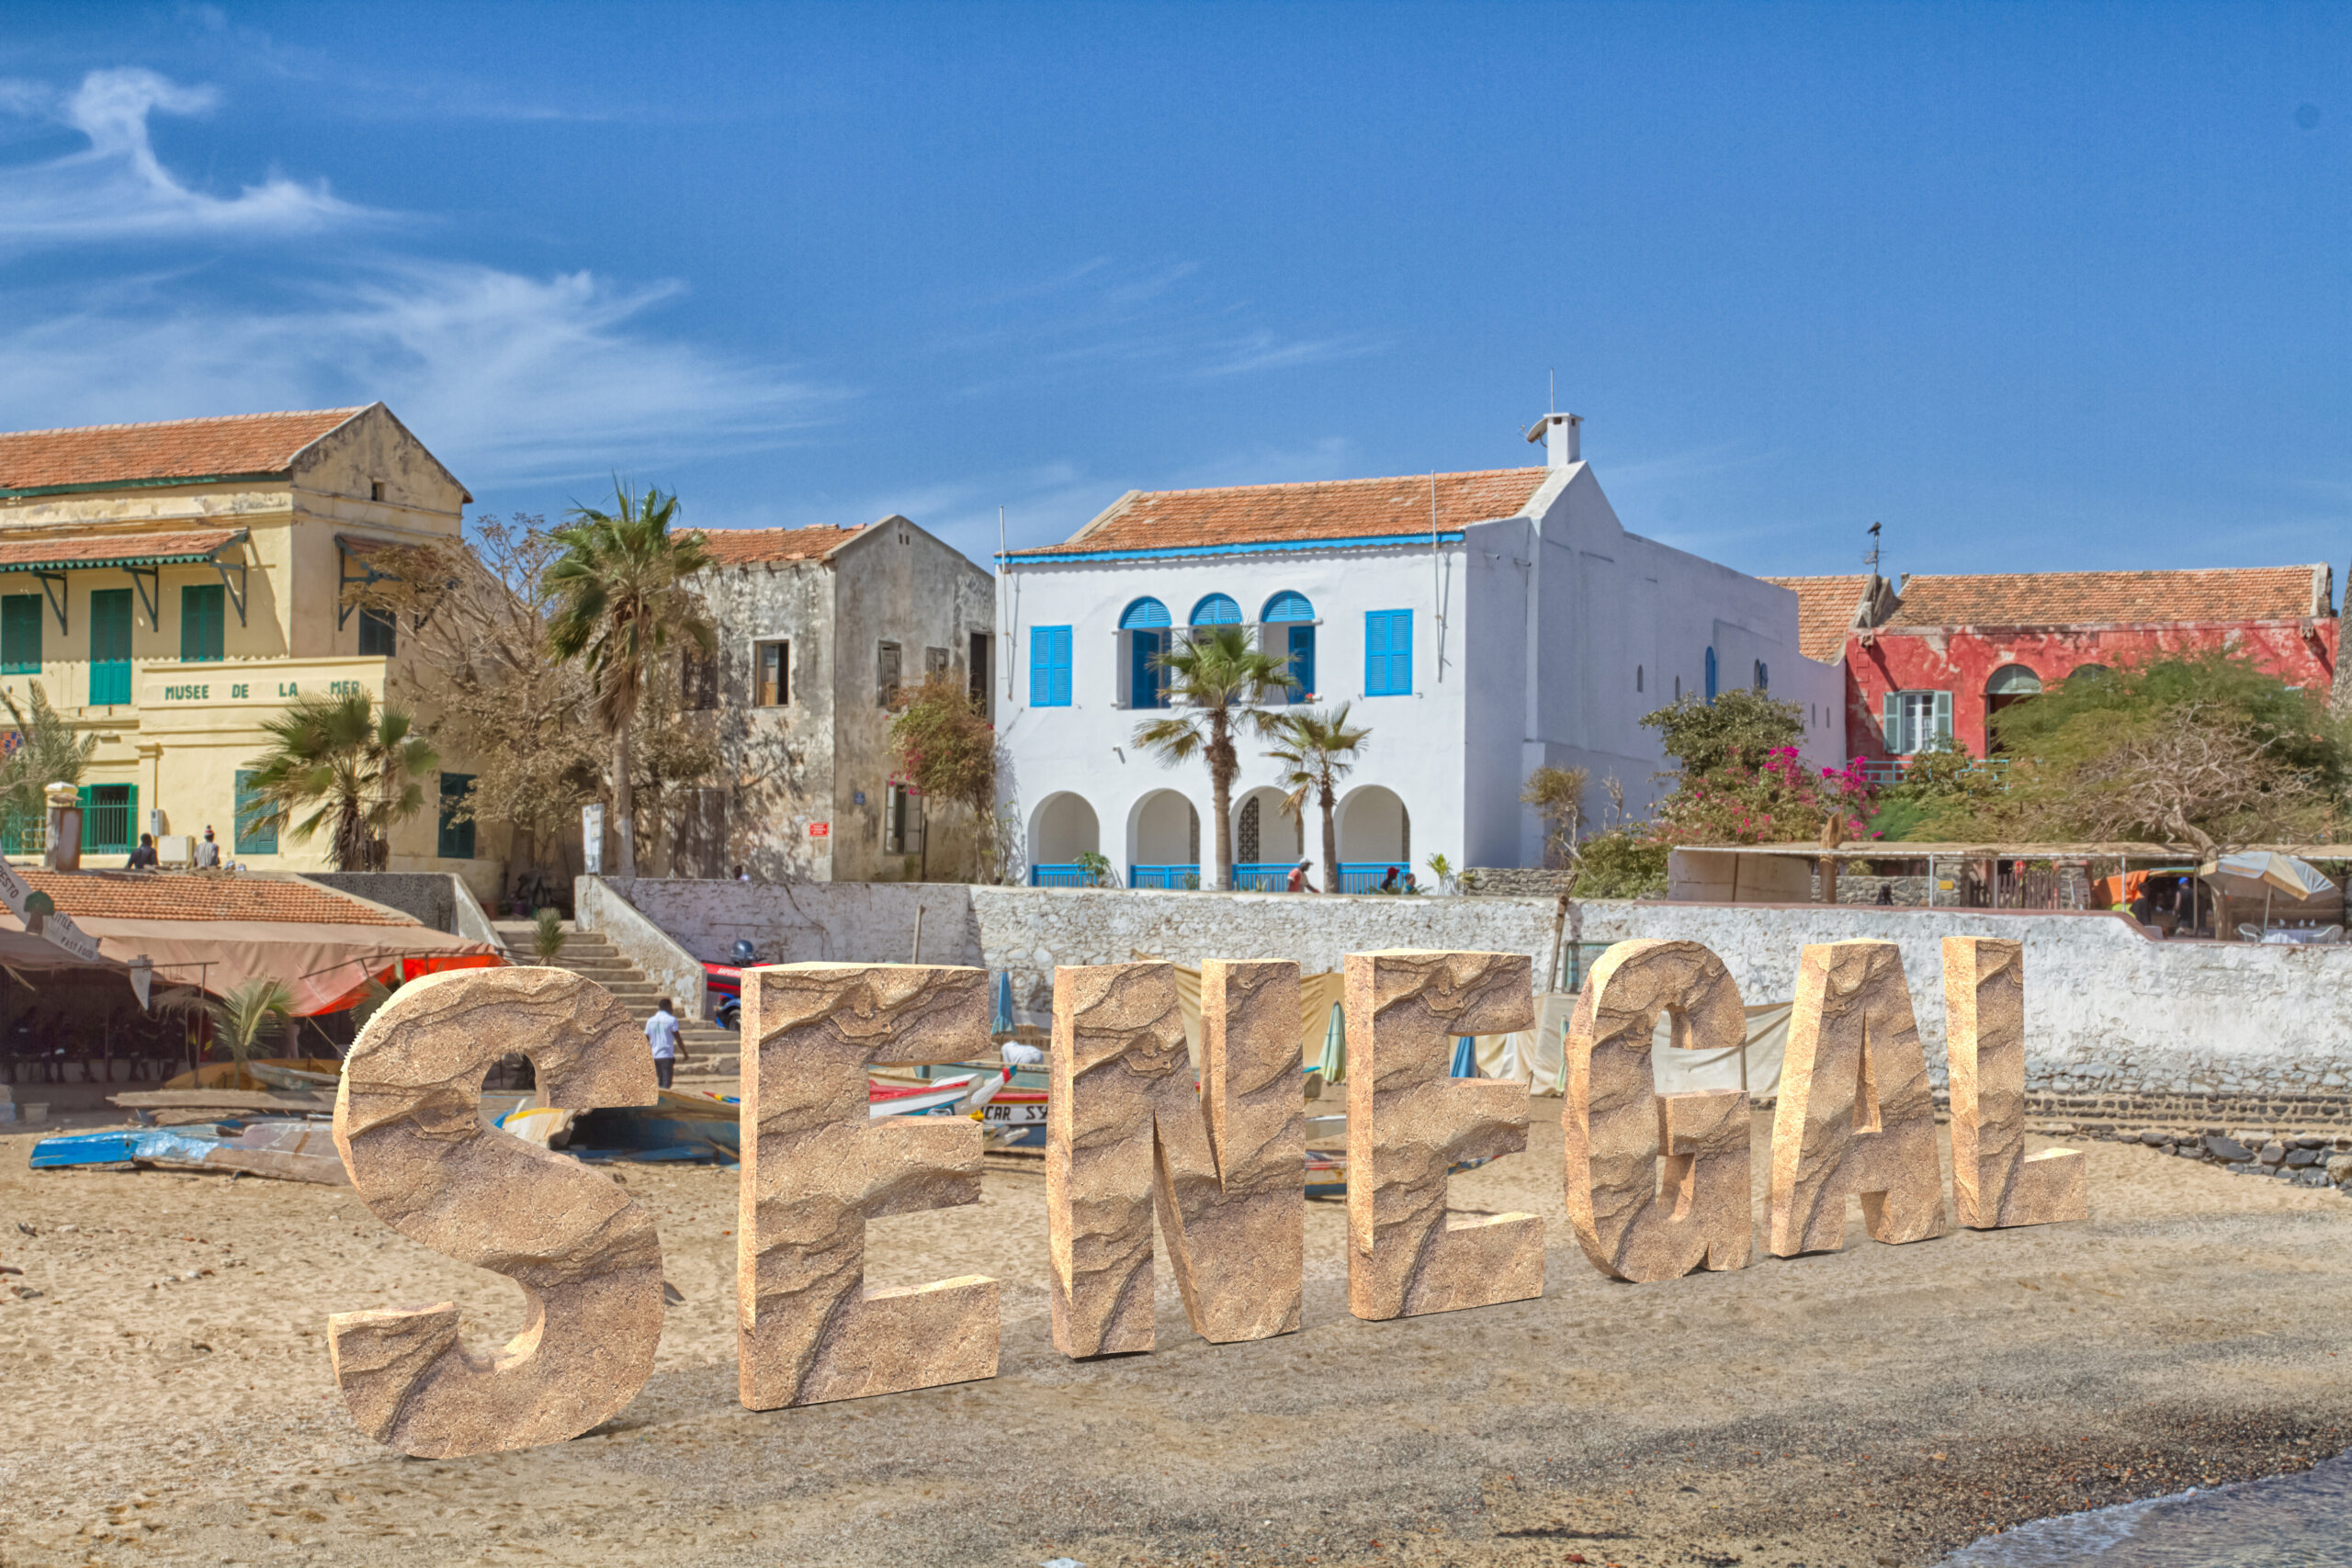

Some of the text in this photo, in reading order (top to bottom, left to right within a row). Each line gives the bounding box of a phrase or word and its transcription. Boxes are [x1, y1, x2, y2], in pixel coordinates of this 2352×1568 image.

[164, 681, 360, 700] MUSEE DE LA MER
[0, 866, 19, 898] ESTO
[61, 936, 95, 958] FAST FOOD
